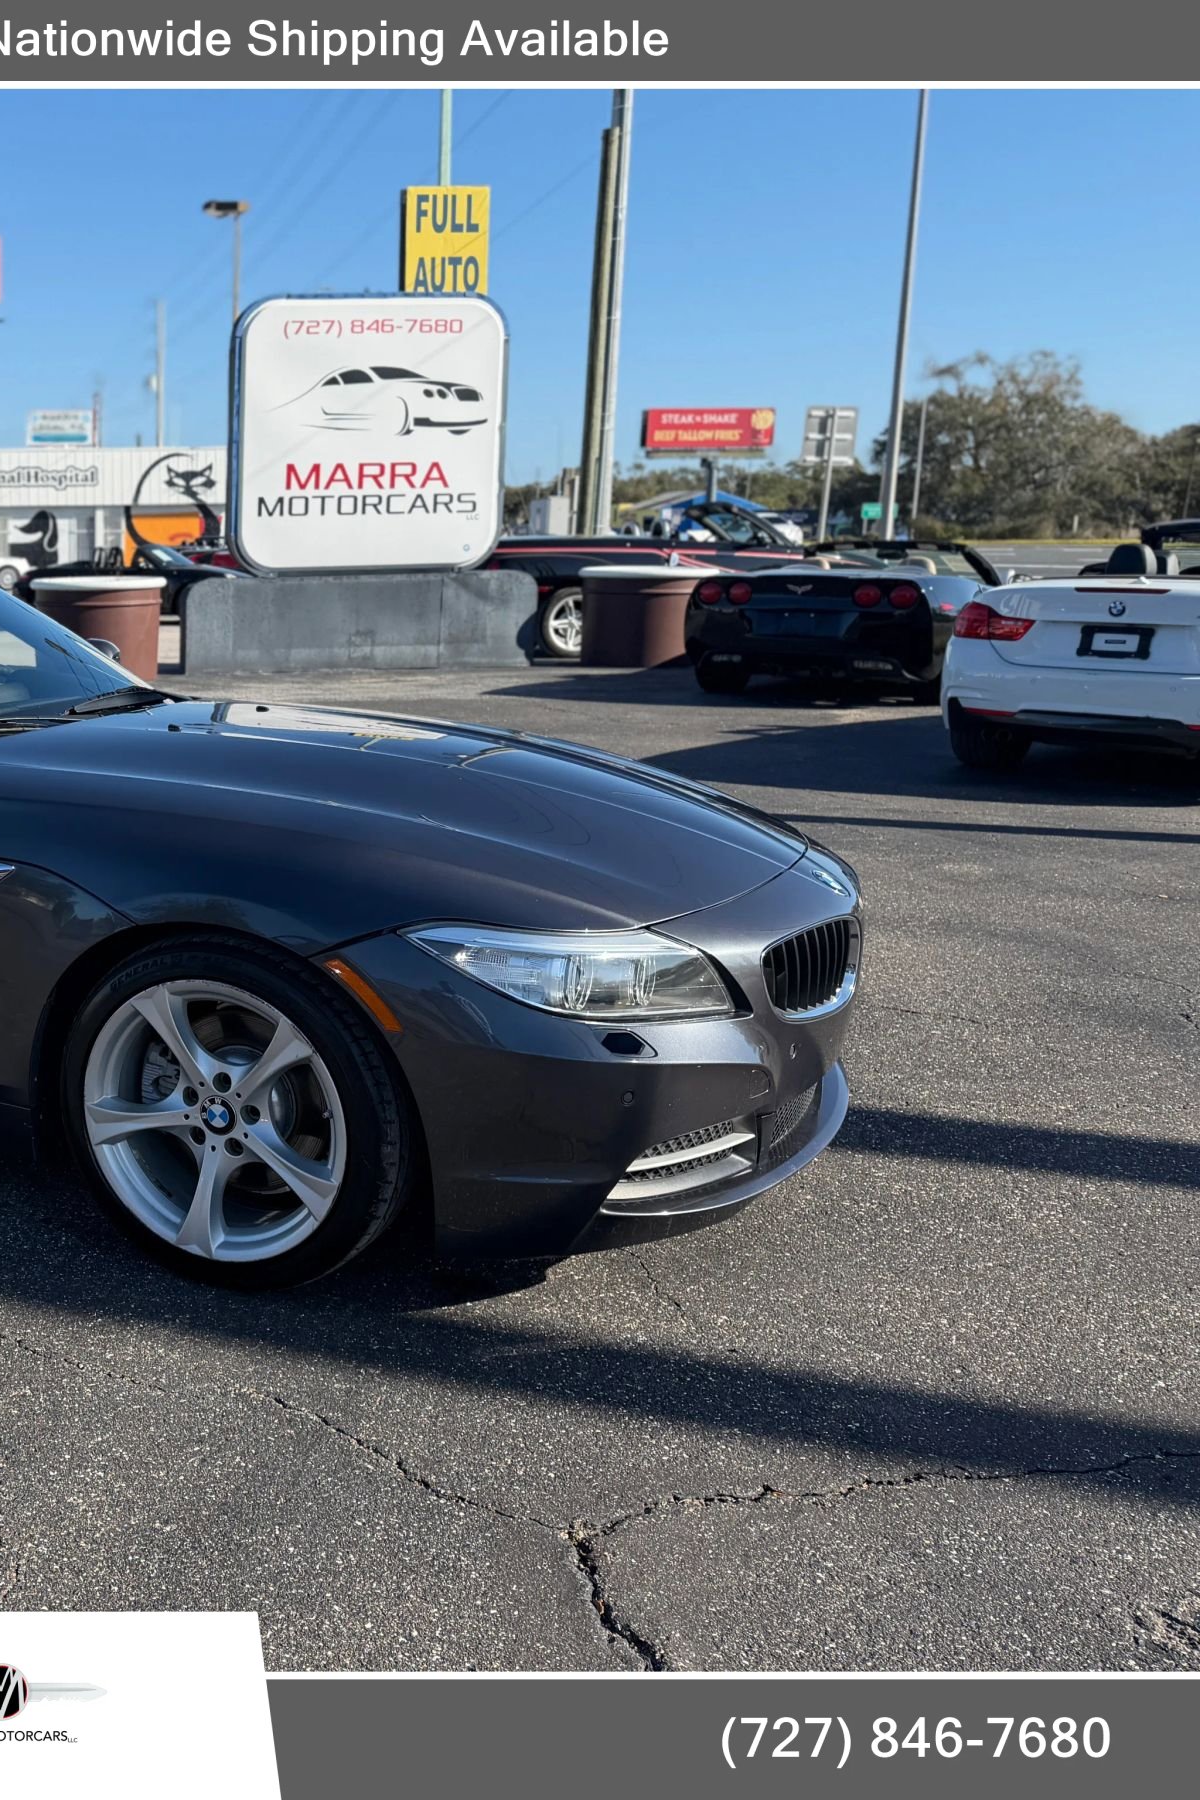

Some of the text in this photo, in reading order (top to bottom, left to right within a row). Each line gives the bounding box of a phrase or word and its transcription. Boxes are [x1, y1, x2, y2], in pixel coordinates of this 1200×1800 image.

[415, 194, 480, 233] FULL
[414, 256, 479, 292] AUTO
[284, 318, 464, 338] (727) 846-7680
[26, 469, 96, 487] Hospital
[285, 461, 449, 491] MARRA
[257, 492, 478, 517] MOTORCARS
